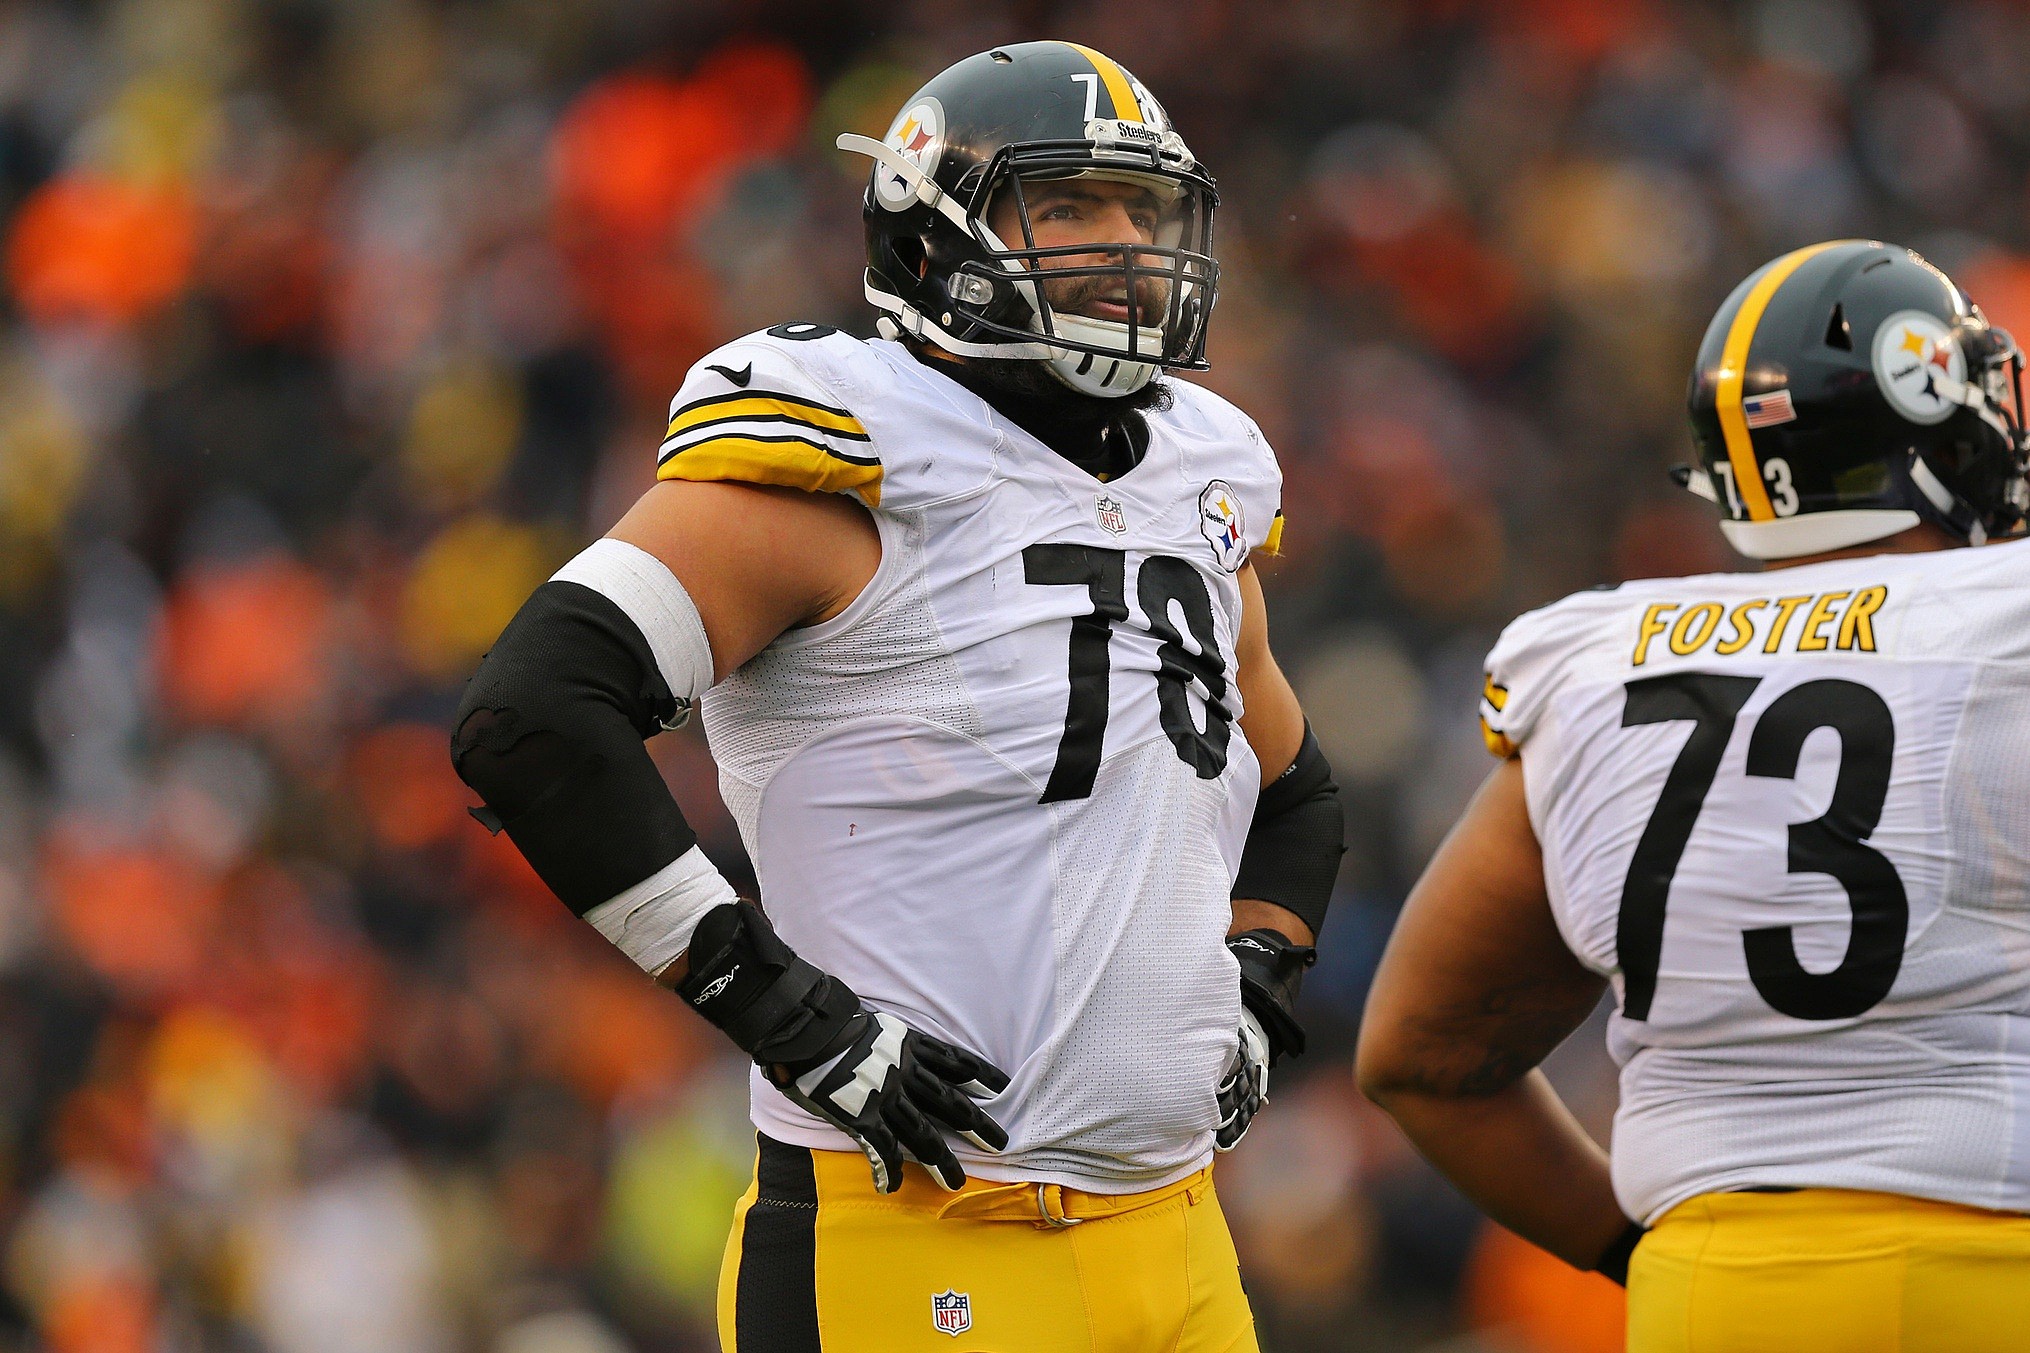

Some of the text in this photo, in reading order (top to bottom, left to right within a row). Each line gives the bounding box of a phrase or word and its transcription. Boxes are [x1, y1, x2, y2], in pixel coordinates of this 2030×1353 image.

[1117, 121, 1162, 144] Steelers
[1101, 511, 1124, 530] NFL
[1632, 584, 1888, 667] FOSTER
[1021, 543, 1233, 804] 78
[1617, 671, 1909, 1021] 73
[939, 1310, 966, 1329] NFL
